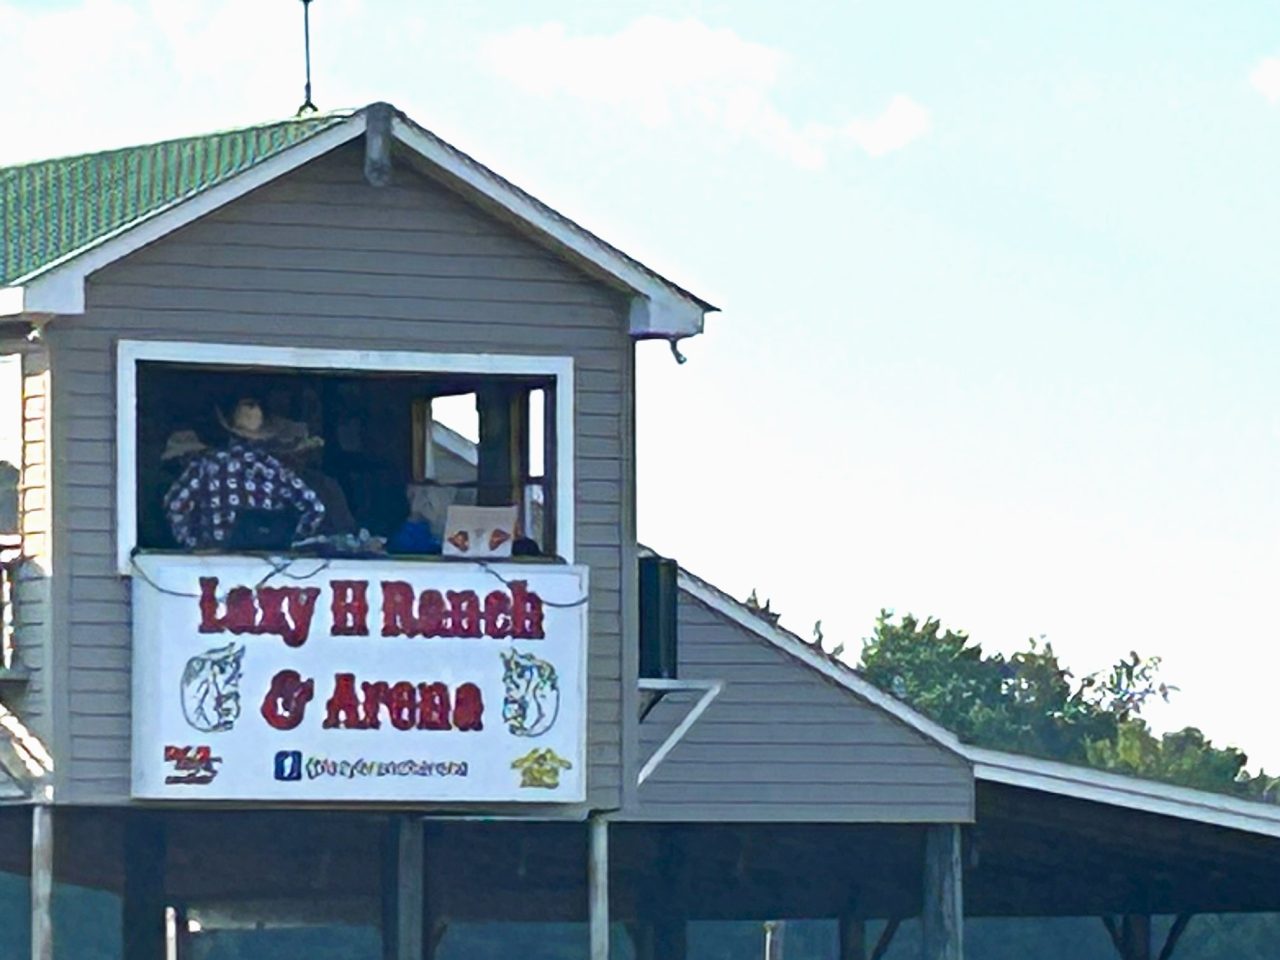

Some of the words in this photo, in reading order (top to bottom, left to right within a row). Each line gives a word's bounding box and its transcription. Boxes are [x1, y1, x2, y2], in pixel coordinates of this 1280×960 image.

[199, 576, 321, 647] Lazy
[330, 580, 369, 636] H
[381, 579, 545, 639] Ranch
[322, 673, 484, 732] Arena
